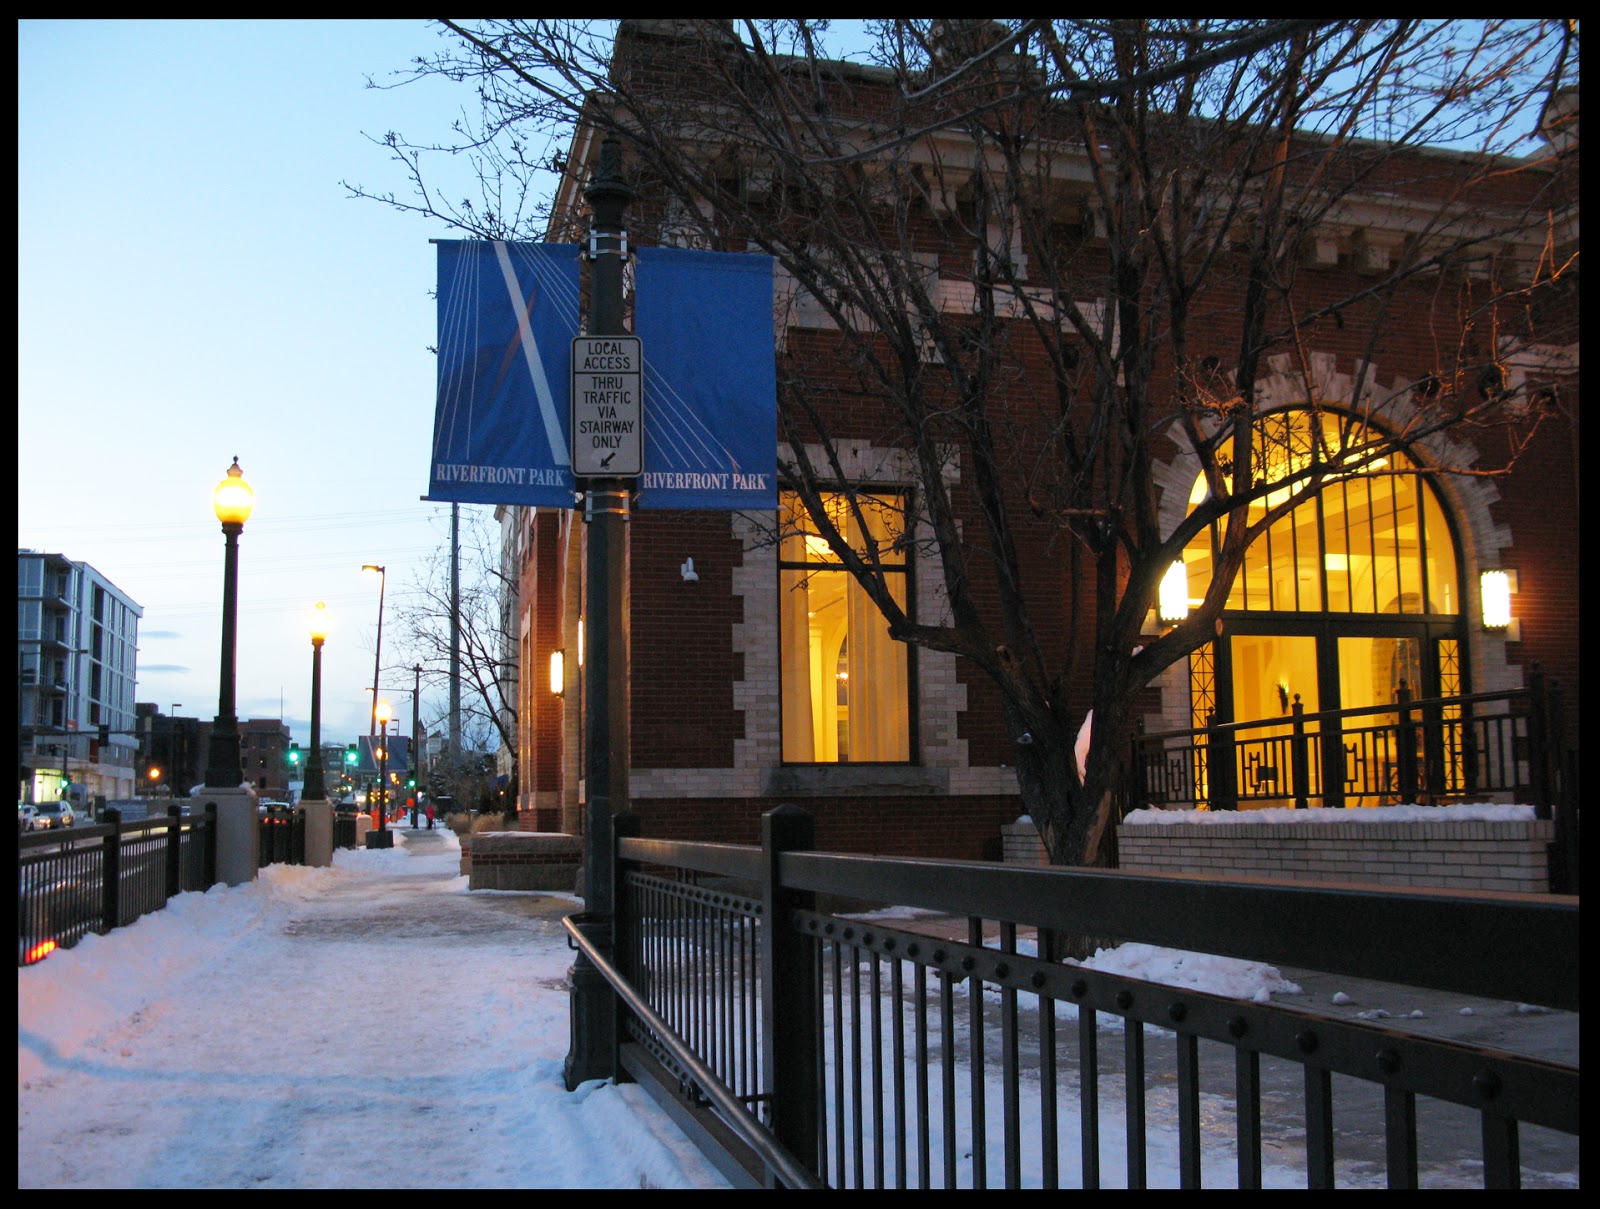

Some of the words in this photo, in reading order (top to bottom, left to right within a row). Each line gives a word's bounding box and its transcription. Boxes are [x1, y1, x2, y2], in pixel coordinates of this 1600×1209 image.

[588, 342, 625, 355] LOCAL
[584, 357, 630, 370] ACCESS
[592, 376, 623, 389] THRU
[584, 391, 631, 404] TRAFFIC
[598, 406, 616, 419] VIA
[580, 421, 634, 434] STAIRWAY
[592, 436, 622, 448] ONLY
[436, 463, 525, 485] RIVERFRONT
[529, 468, 564, 486] PARK
[643, 472, 729, 489] RIVERFRONT
[732, 473, 766, 490] PARK
